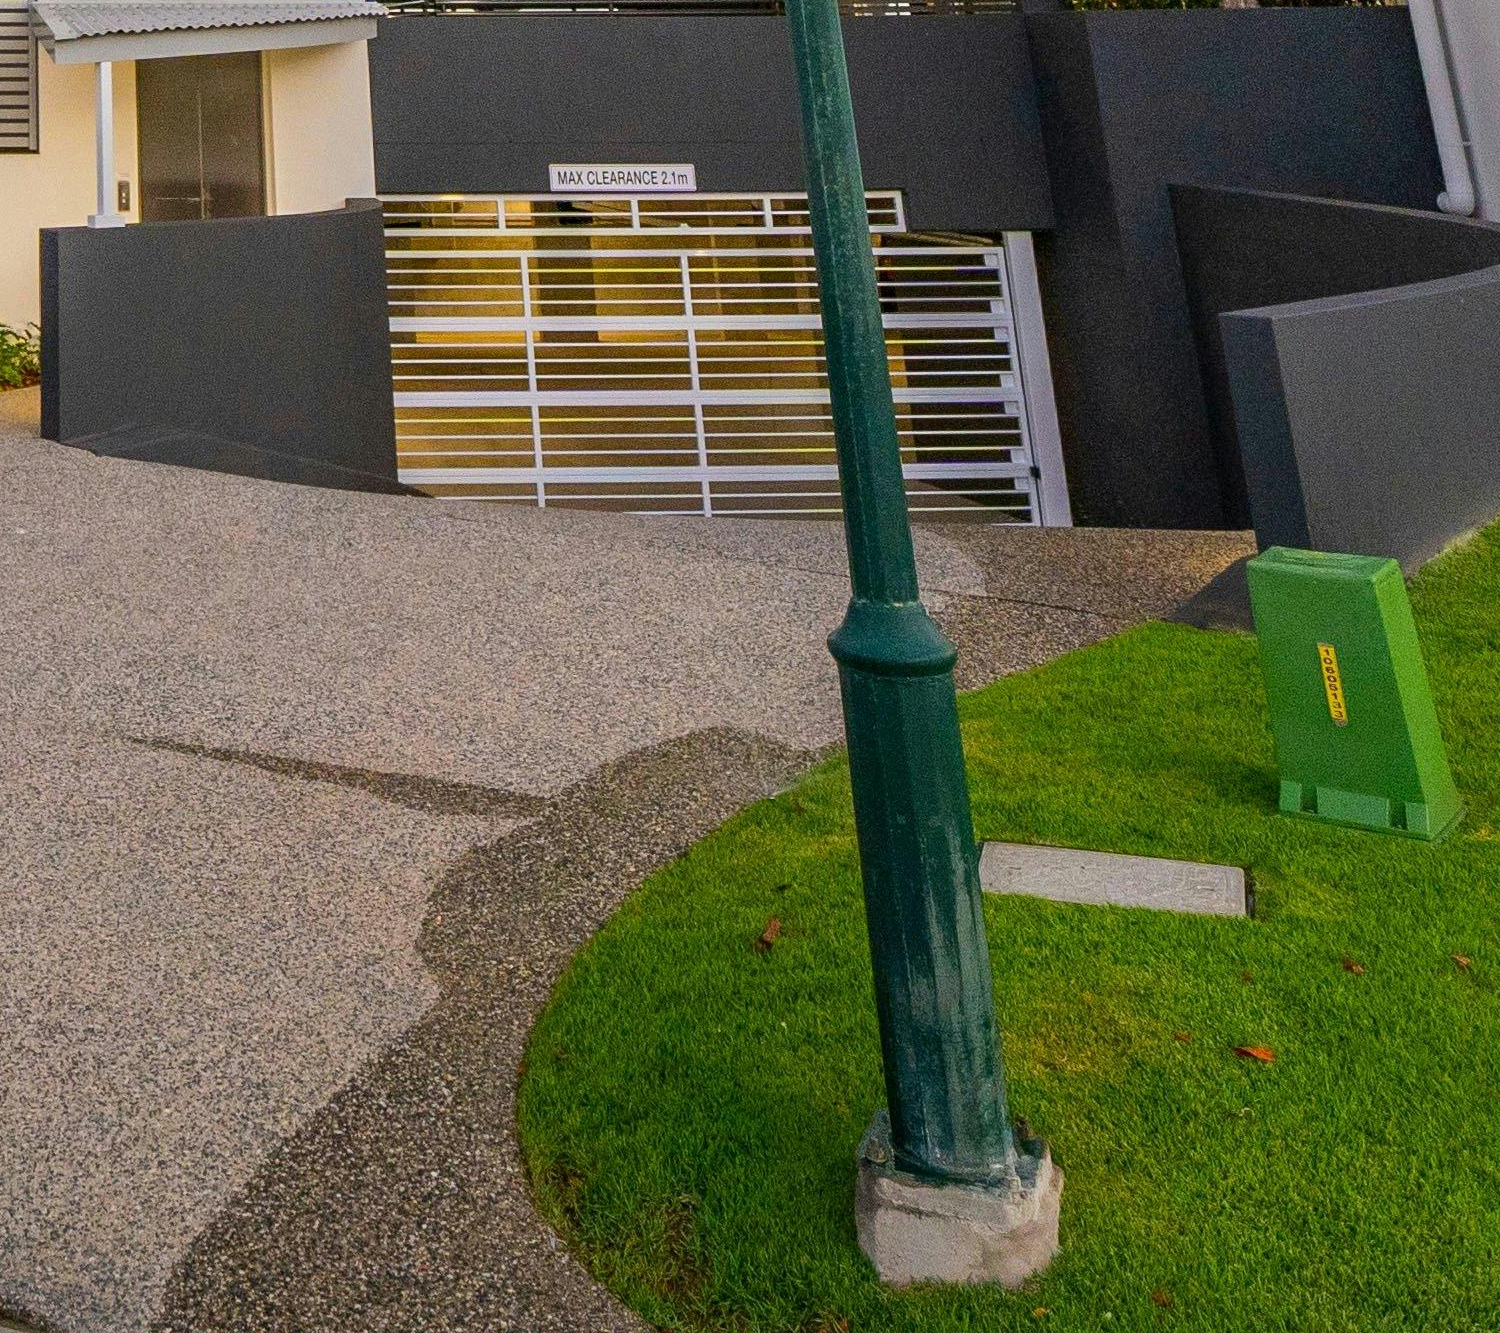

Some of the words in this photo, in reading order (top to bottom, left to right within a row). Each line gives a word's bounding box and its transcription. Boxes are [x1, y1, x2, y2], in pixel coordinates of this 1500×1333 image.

[557, 170, 584, 185] MAX
[586, 170, 658, 186] CLEARANCE
[661, 170, 689, 185] 2.1m
